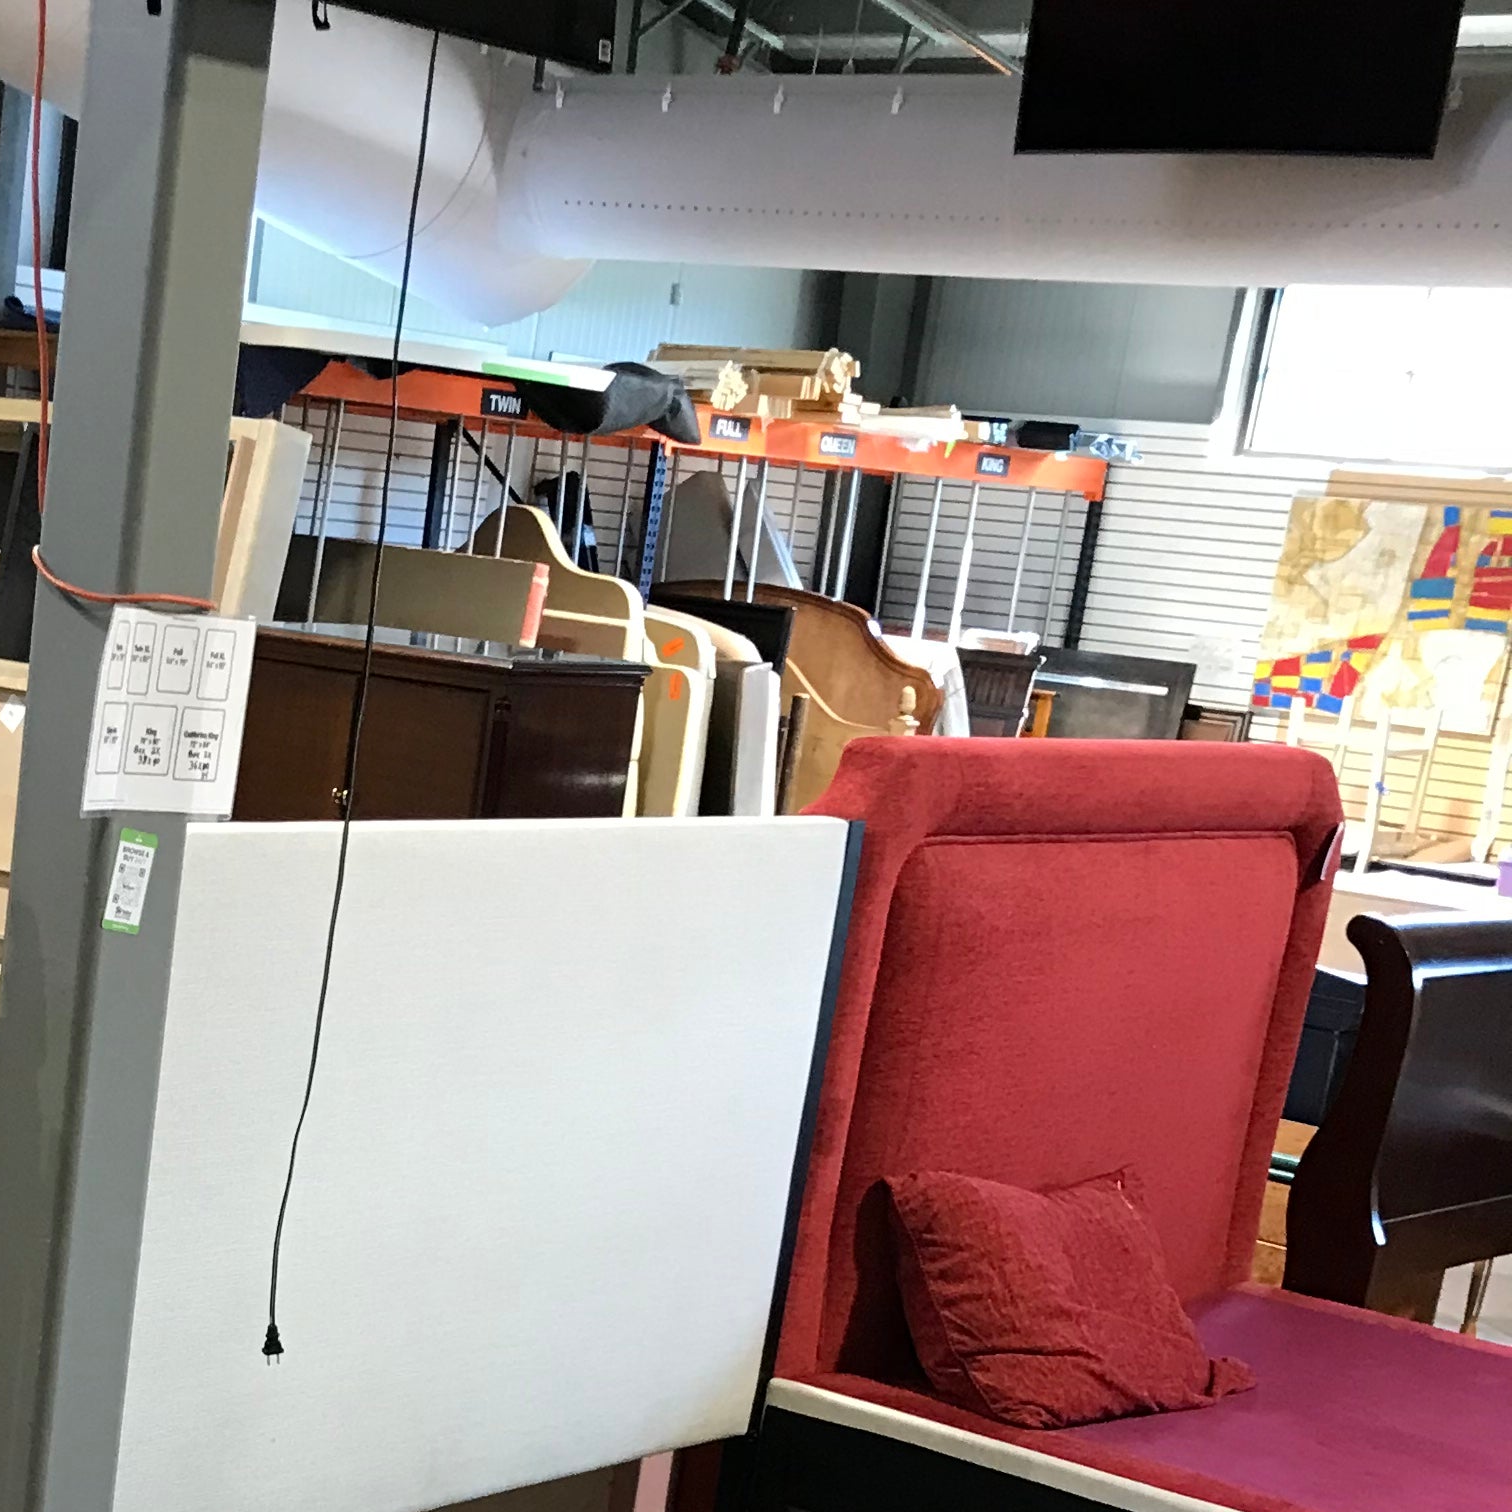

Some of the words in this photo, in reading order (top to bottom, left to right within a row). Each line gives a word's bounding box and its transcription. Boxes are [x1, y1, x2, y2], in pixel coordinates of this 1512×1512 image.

[489, 394, 522, 415] TWIN
[715, 418, 743, 438] FULL
[820, 434, 856, 454] QUEEN
[981, 456, 1004, 473] KING
